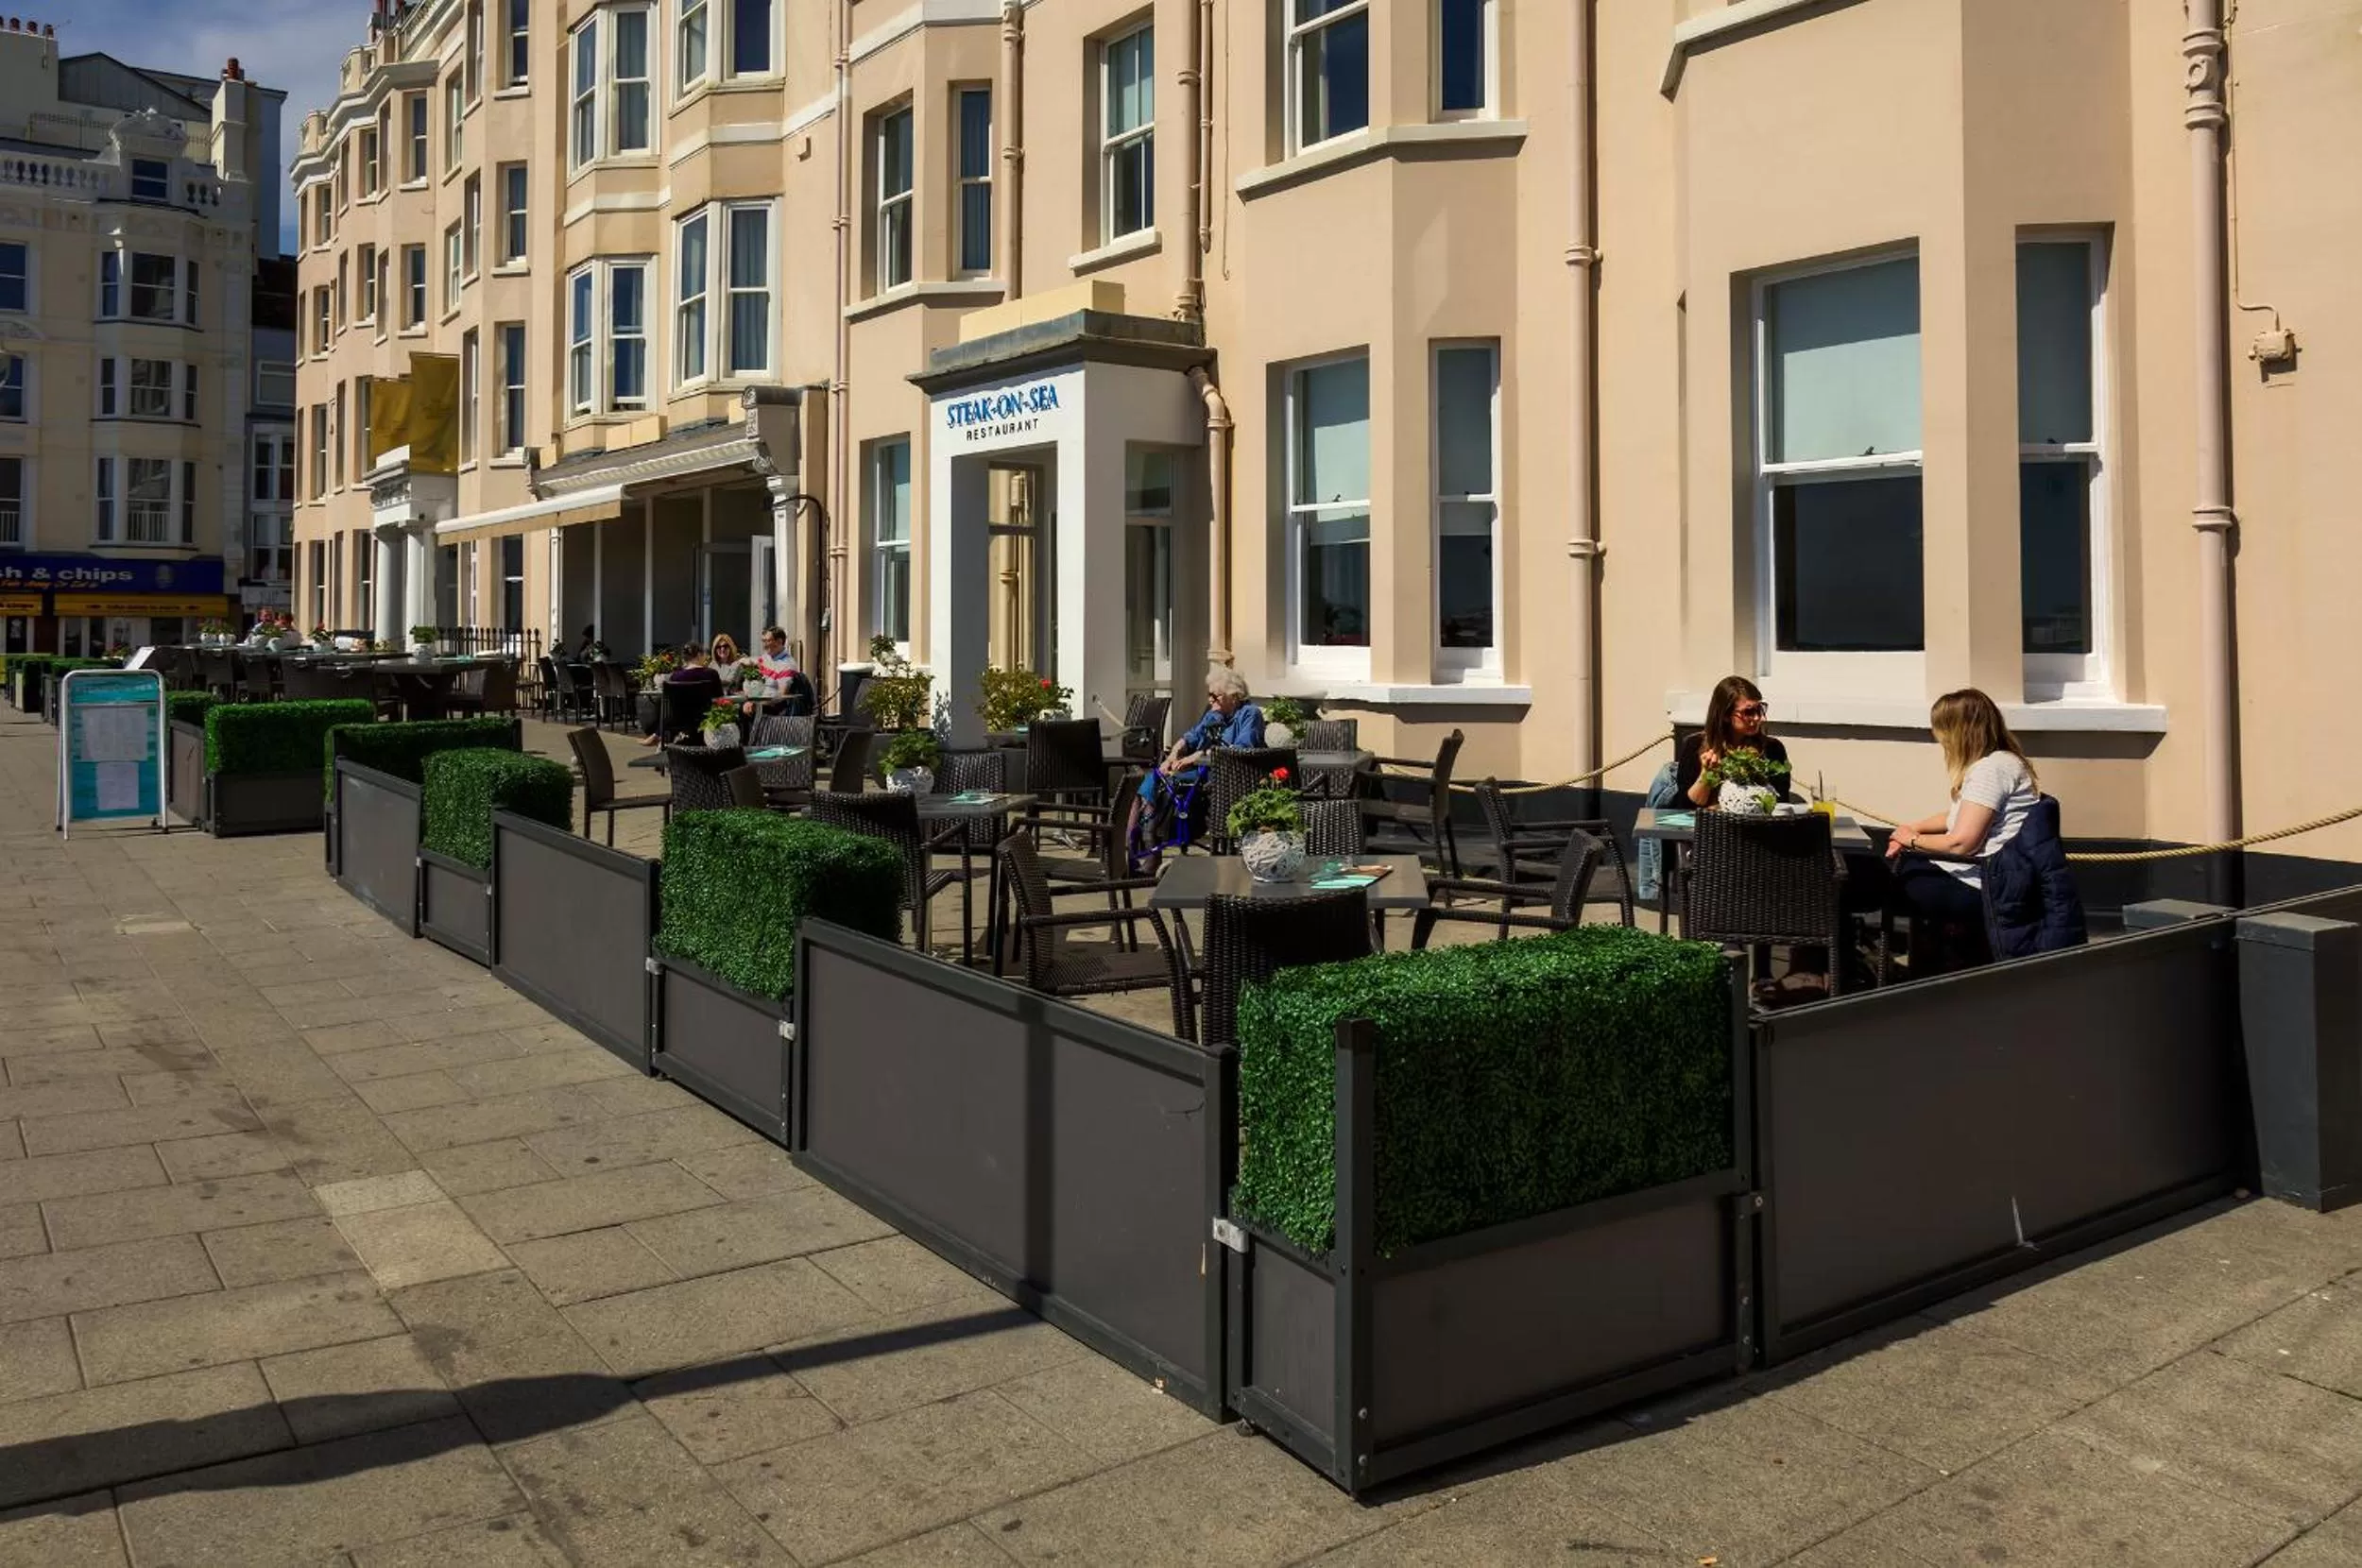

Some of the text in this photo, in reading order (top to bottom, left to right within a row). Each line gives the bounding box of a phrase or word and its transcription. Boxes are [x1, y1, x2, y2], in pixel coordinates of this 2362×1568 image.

[947, 383, 1059, 429] STEAK-ON-SEA
[966, 418, 1039, 442] RESTAURANT
[0, 565, 135, 584] h & chips
